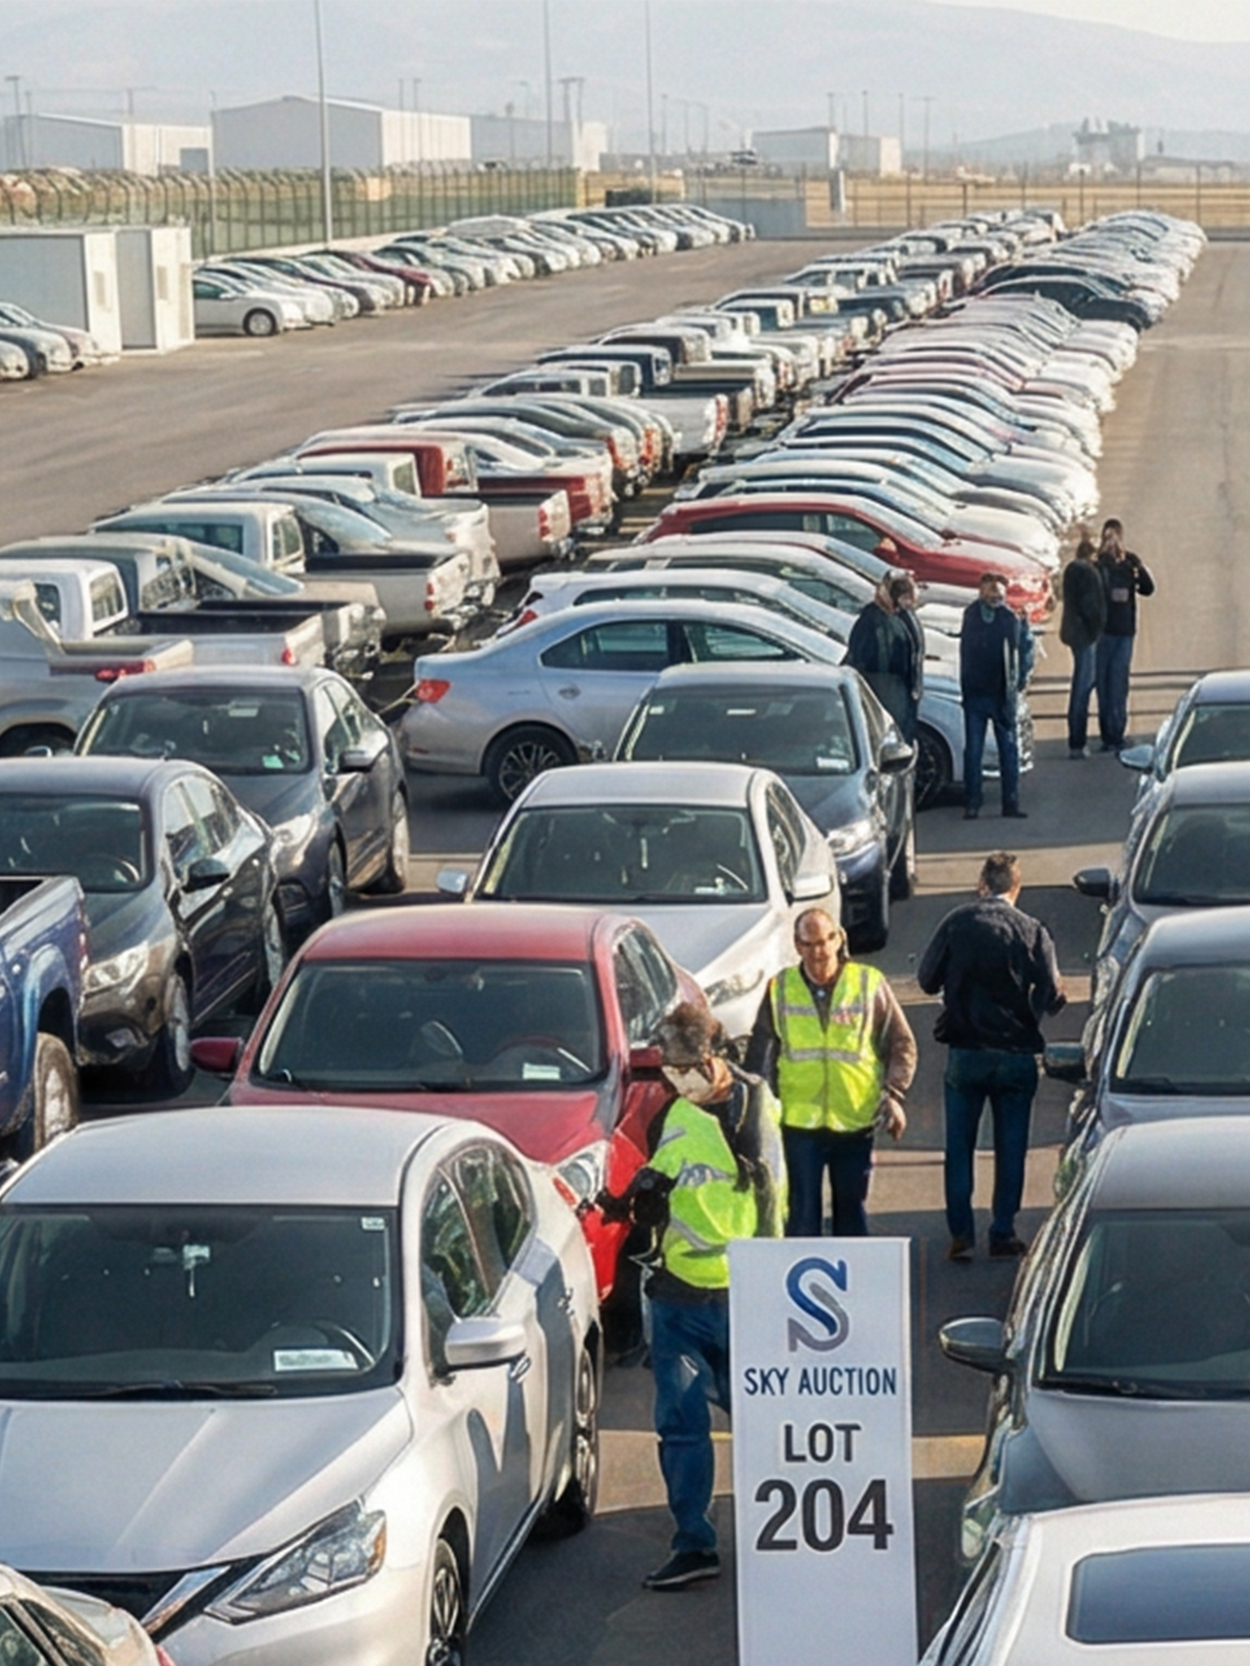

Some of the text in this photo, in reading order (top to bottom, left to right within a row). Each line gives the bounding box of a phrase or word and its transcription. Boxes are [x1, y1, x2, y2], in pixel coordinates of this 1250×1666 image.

[744, 1368, 897, 1395] SKY AUCTION
[784, 1423, 861, 1462] LOT
[755, 1479, 894, 1552] 204
